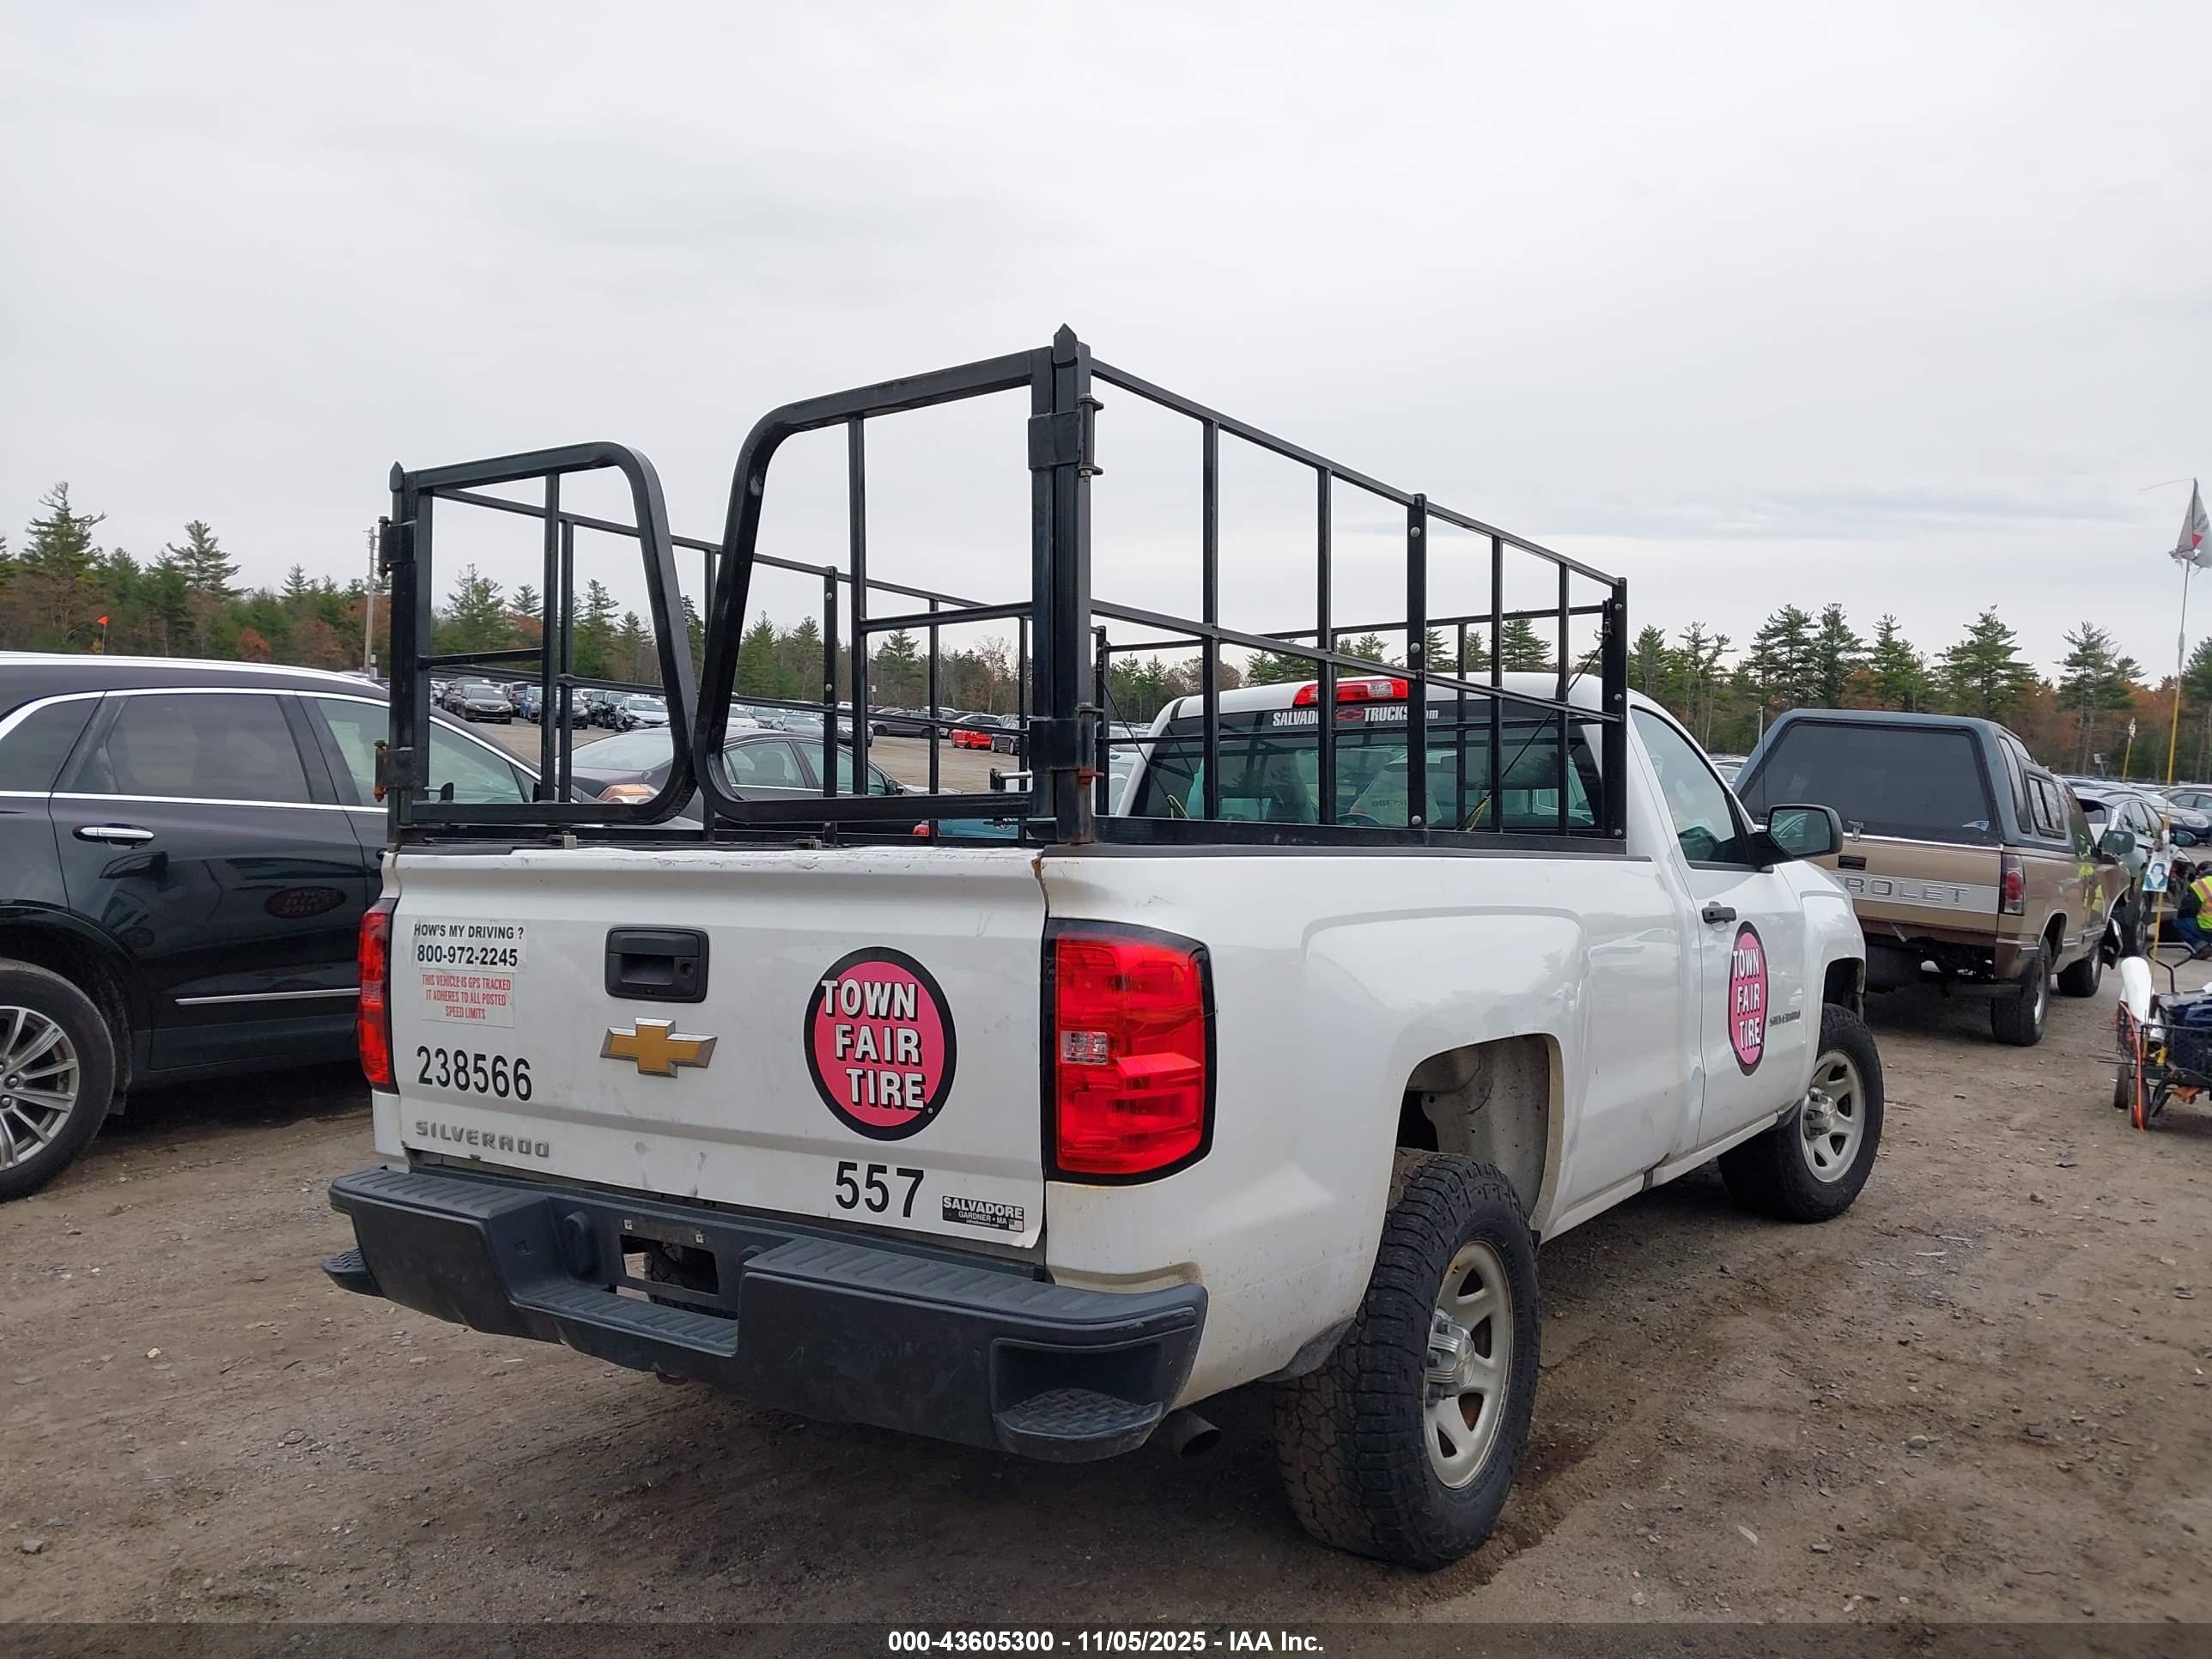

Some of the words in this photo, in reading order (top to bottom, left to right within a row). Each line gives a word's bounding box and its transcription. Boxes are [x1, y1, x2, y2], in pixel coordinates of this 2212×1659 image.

[414, 924, 446, 937] HOW'S
[448, 925, 465, 938] MY
[468, 926, 514, 939] DRIVING
[417, 945, 518, 967] 800-972-2245
[1733, 948, 1759, 979] TOWN
[422, 974, 434, 986] THIS
[436, 975, 460, 988] VEHICLE
[461, 976, 467, 988] IS
[469, 977, 481, 988] GPS
[483, 978, 511, 991] TRACKED
[426, 989, 432, 1000] IT
[433, 990, 459, 1003] ADHERES
[460, 992, 469, 1003] TO
[470, 993, 481, 1004] ALL
[482, 994, 506, 1006] POSTED
[1737, 982, 1760, 1014] FAIR
[445, 1006, 464, 1018] SPEED
[465, 1007, 486, 1020] LIMITS
[821, 978, 917, 1020] TOWN
[835, 1024, 921, 1065] FAIR
[1739, 1017, 1761, 1049] TIRE
[416, 1046, 532, 1102] 238566
[845, 1068, 925, 1109] TIRE
[416, 1120, 550, 1158] SILVERADO
[835, 1161, 924, 1218] 557
[943, 1196, 1024, 1219] SALVADORE
[958, 1211, 991, 1222] GARDNER
[996, 1216, 1007, 1224] MA
